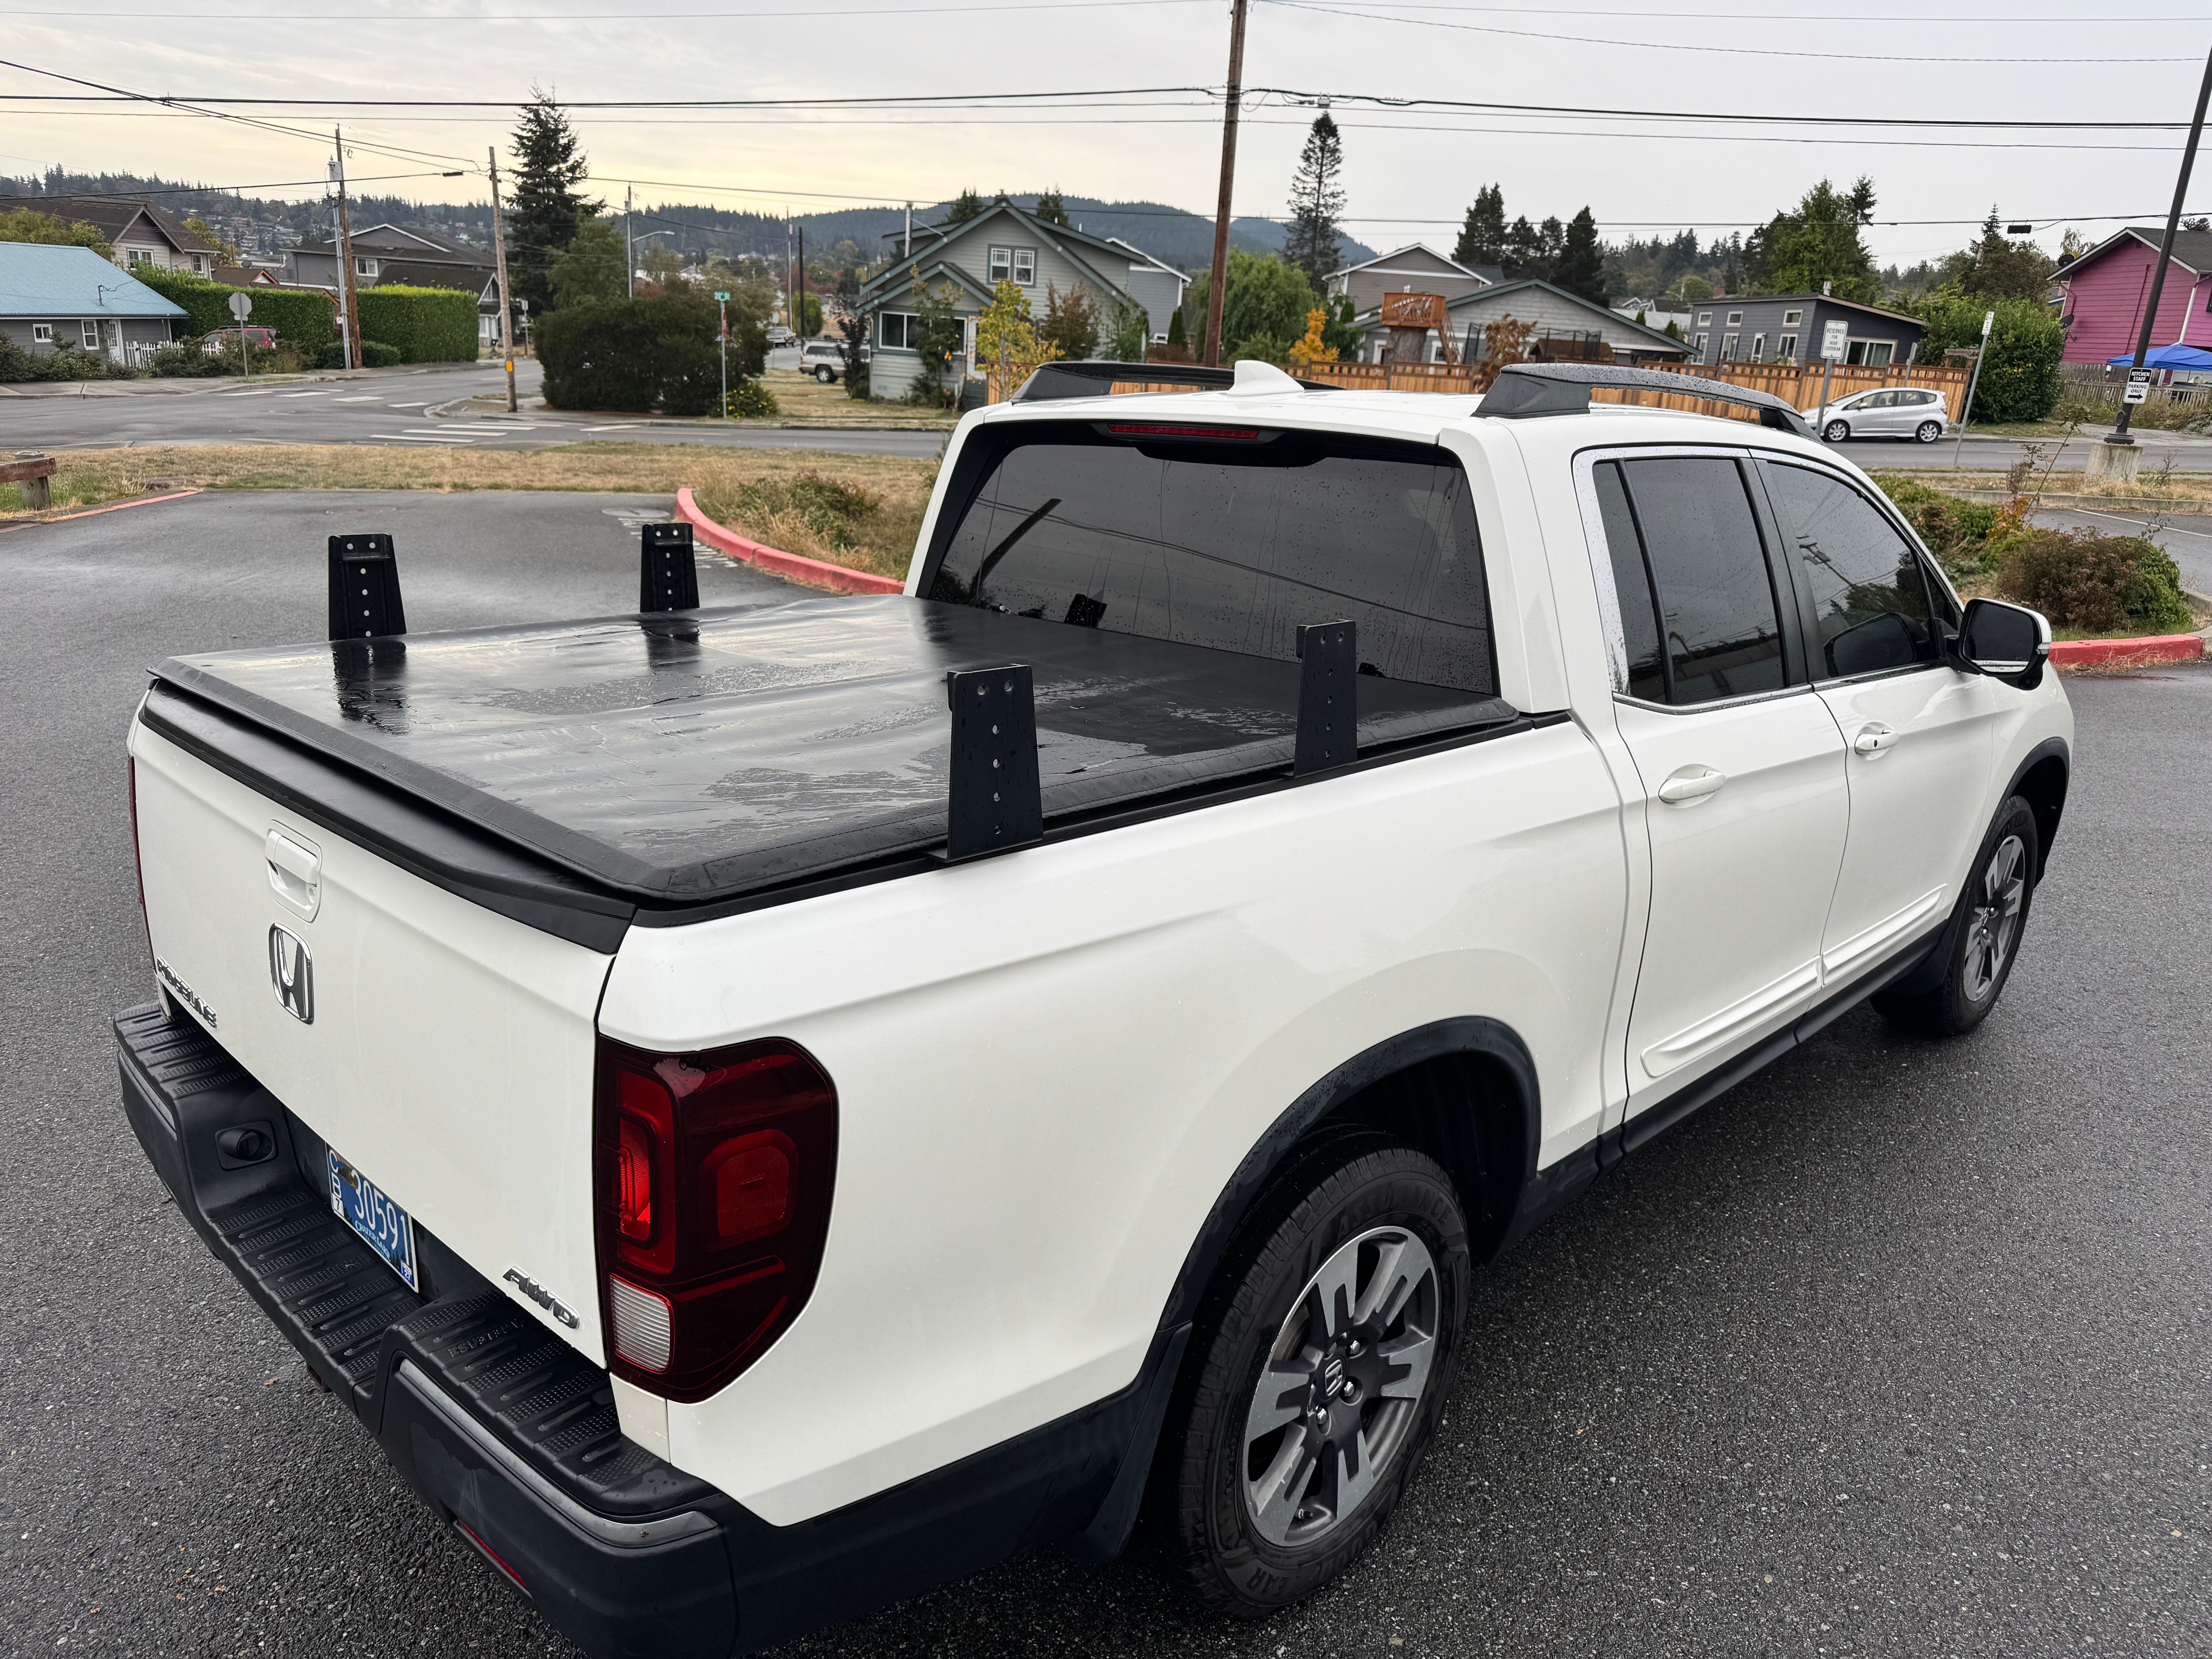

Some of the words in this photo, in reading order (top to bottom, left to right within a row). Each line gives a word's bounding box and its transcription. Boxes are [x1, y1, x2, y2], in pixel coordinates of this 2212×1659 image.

[156, 956, 217, 1029] RIDGELINE
[351, 1169, 410, 1266] 30591
[355, 1220, 377, 1243] CRATER
[1336, 1185, 1452, 1243] ASSURANCE
[502, 1266, 580, 1329] AWD
